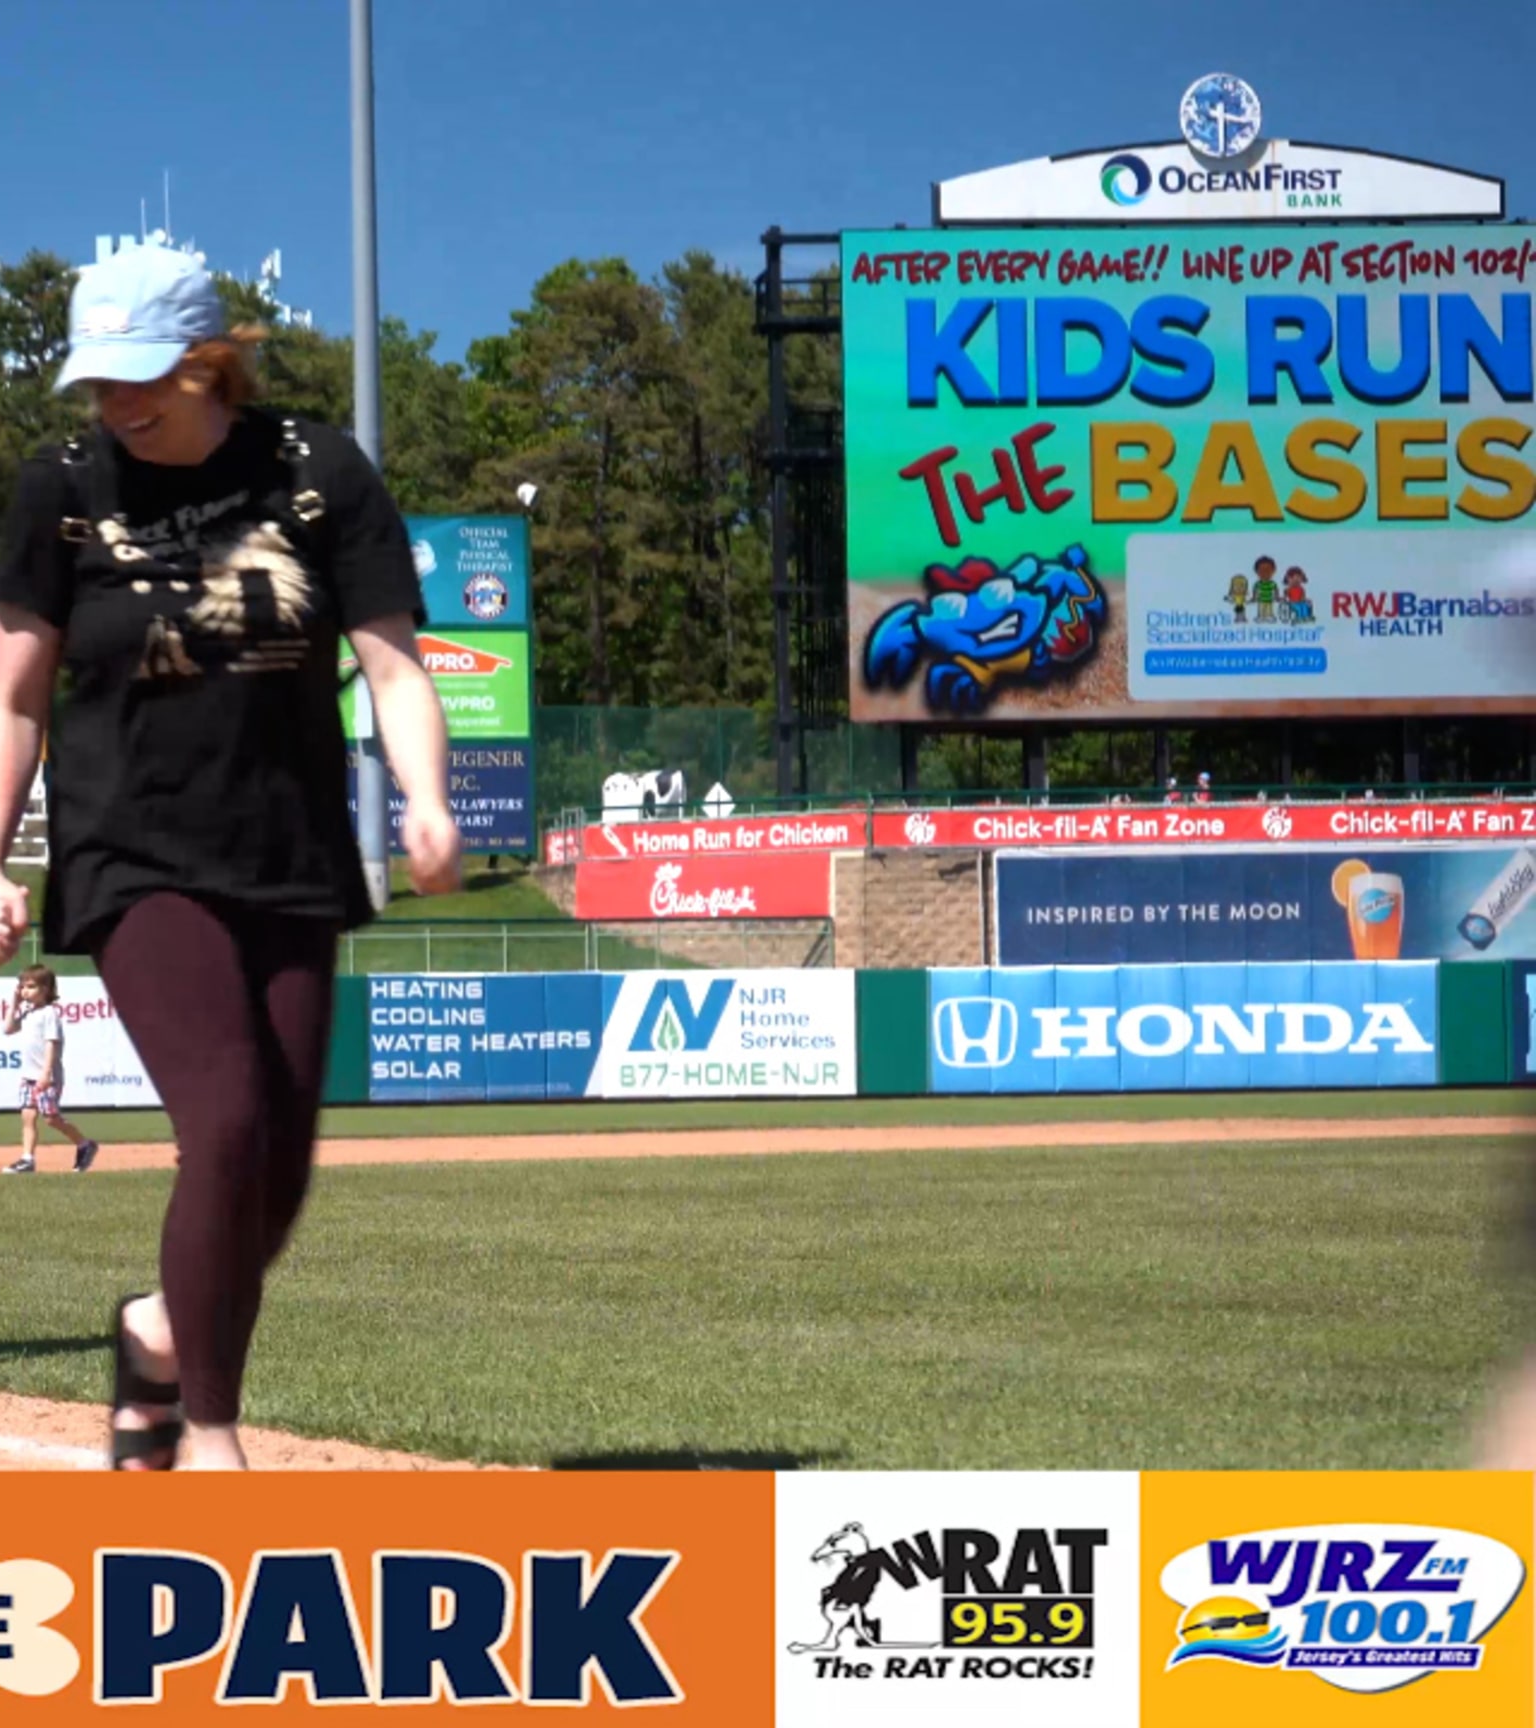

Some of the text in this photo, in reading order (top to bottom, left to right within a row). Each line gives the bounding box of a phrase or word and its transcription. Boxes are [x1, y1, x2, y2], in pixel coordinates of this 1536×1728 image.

[1287, 195, 1342, 208] BANK
[852, 251, 951, 285] AFTER
[957, 250, 1049, 285] EVERY
[1057, 244, 1169, 286] GAME!!
[1182, 246, 1244, 285] LINE
[1250, 249, 1293, 280] UP
[1298, 241, 1339, 285] AT
[1341, 240, 1456, 285] SECTION
[905, 293, 1534, 408] KIDS RUN
[899, 418, 1536, 547] THE BASES
[470, 540, 500, 549] TEAM
[1331, 590, 1535, 619] RWJBarnabas
[1147, 611, 1231, 627] Children's
[1360, 619, 1444, 637] HEALTH
[1147, 626, 1322, 645] Specialized Hospital
[449, 752, 525, 768] EGENER
[462, 800, 524, 811] LAWYERS
[1118, 814, 1158, 837] Fan
[1165, 813, 1225, 836] Zone
[1473, 810, 1514, 831] Fan
[634, 823, 849, 851] Home Run for Chicken
[1028, 903, 1301, 924] INSPIRED BY THE MOON
[371, 981, 483, 1000] HEATING
[740, 987, 786, 1005] NJR
[371, 1007, 485, 1026] COOLING
[740, 1010, 809, 1028] Home
[1031, 1001, 1434, 1059] HONDA
[372, 1030, 591, 1053] WATER HEATERS
[740, 1030, 836, 1050] Services
[372, 1060, 461, 1079] SOLAR
[620, 1062, 839, 1088] 877-HOME-NJR
